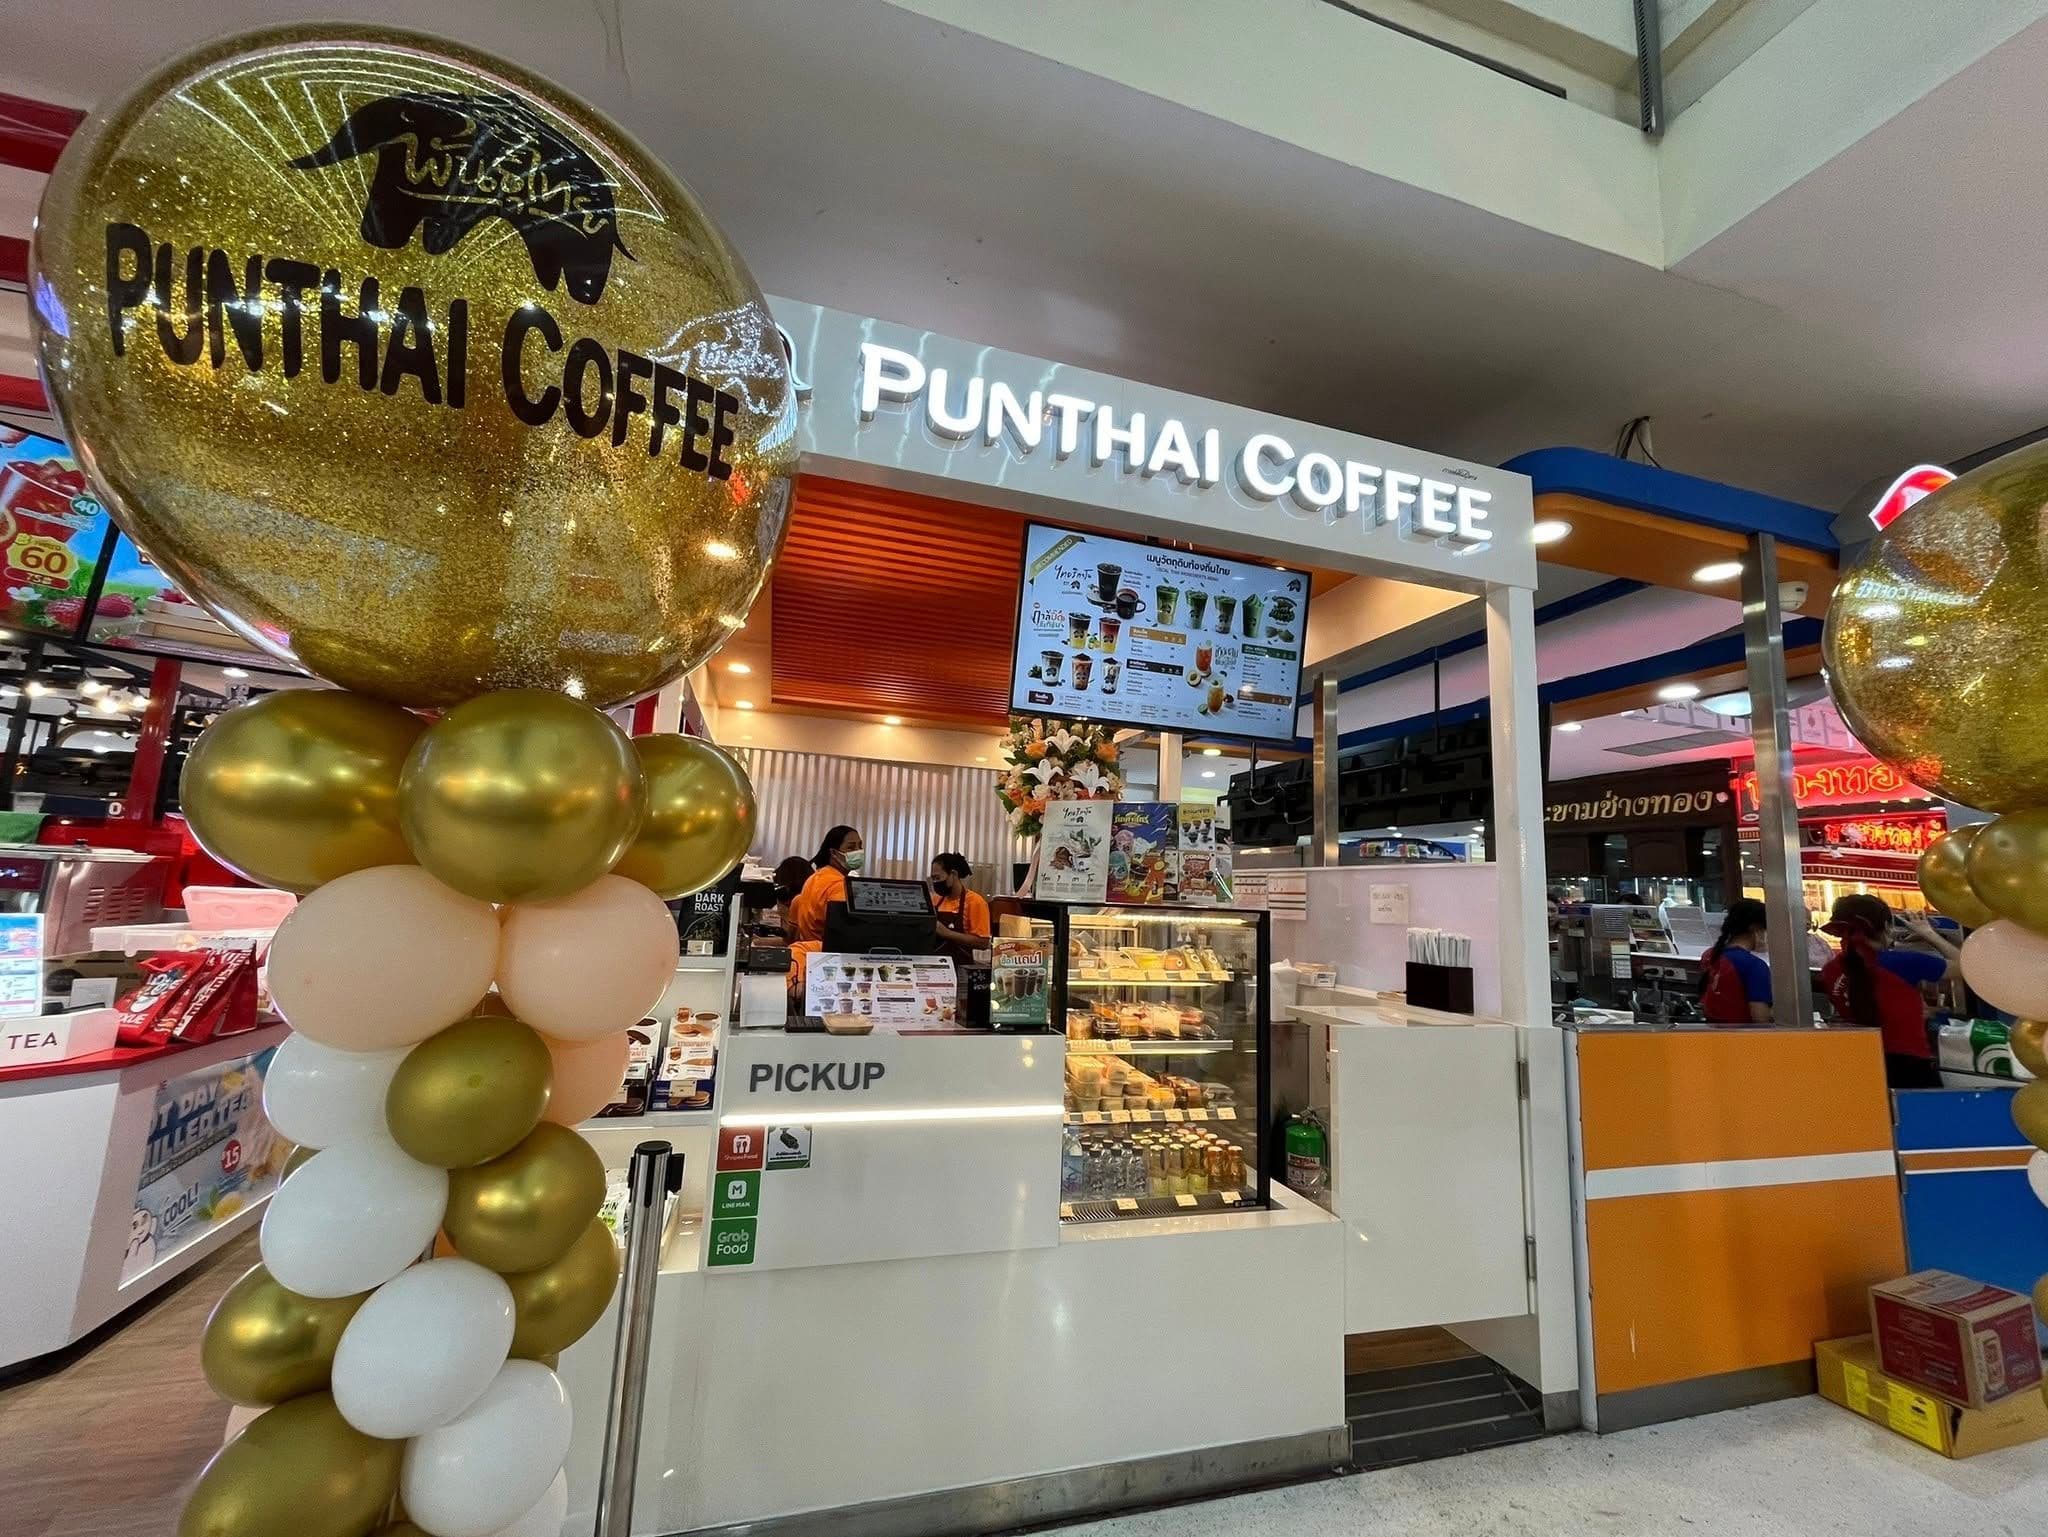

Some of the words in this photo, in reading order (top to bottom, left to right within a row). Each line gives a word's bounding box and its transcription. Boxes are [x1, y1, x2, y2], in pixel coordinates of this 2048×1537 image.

[106, 222, 468, 409] PUNTHAI
[503, 304, 740, 481] COFFEE
[859, 342, 1221, 485] PUNTHAI
[1240, 433, 1493, 541] COFFEE
[75, 500, 99, 515] 40
[20, 547, 68, 574] 60
[694, 903, 724, 911] ROAST
[695, 893, 724, 903] DARK
[8, 1032, 57, 1049] TEA
[749, 1062, 886, 1092] PICKUP
[180, 1080, 221, 1115] DAY
[163, 1182, 199, 1227] COOL!
[717, 1229, 750, 1242] Grab
[715, 1241, 749, 1255] Food
